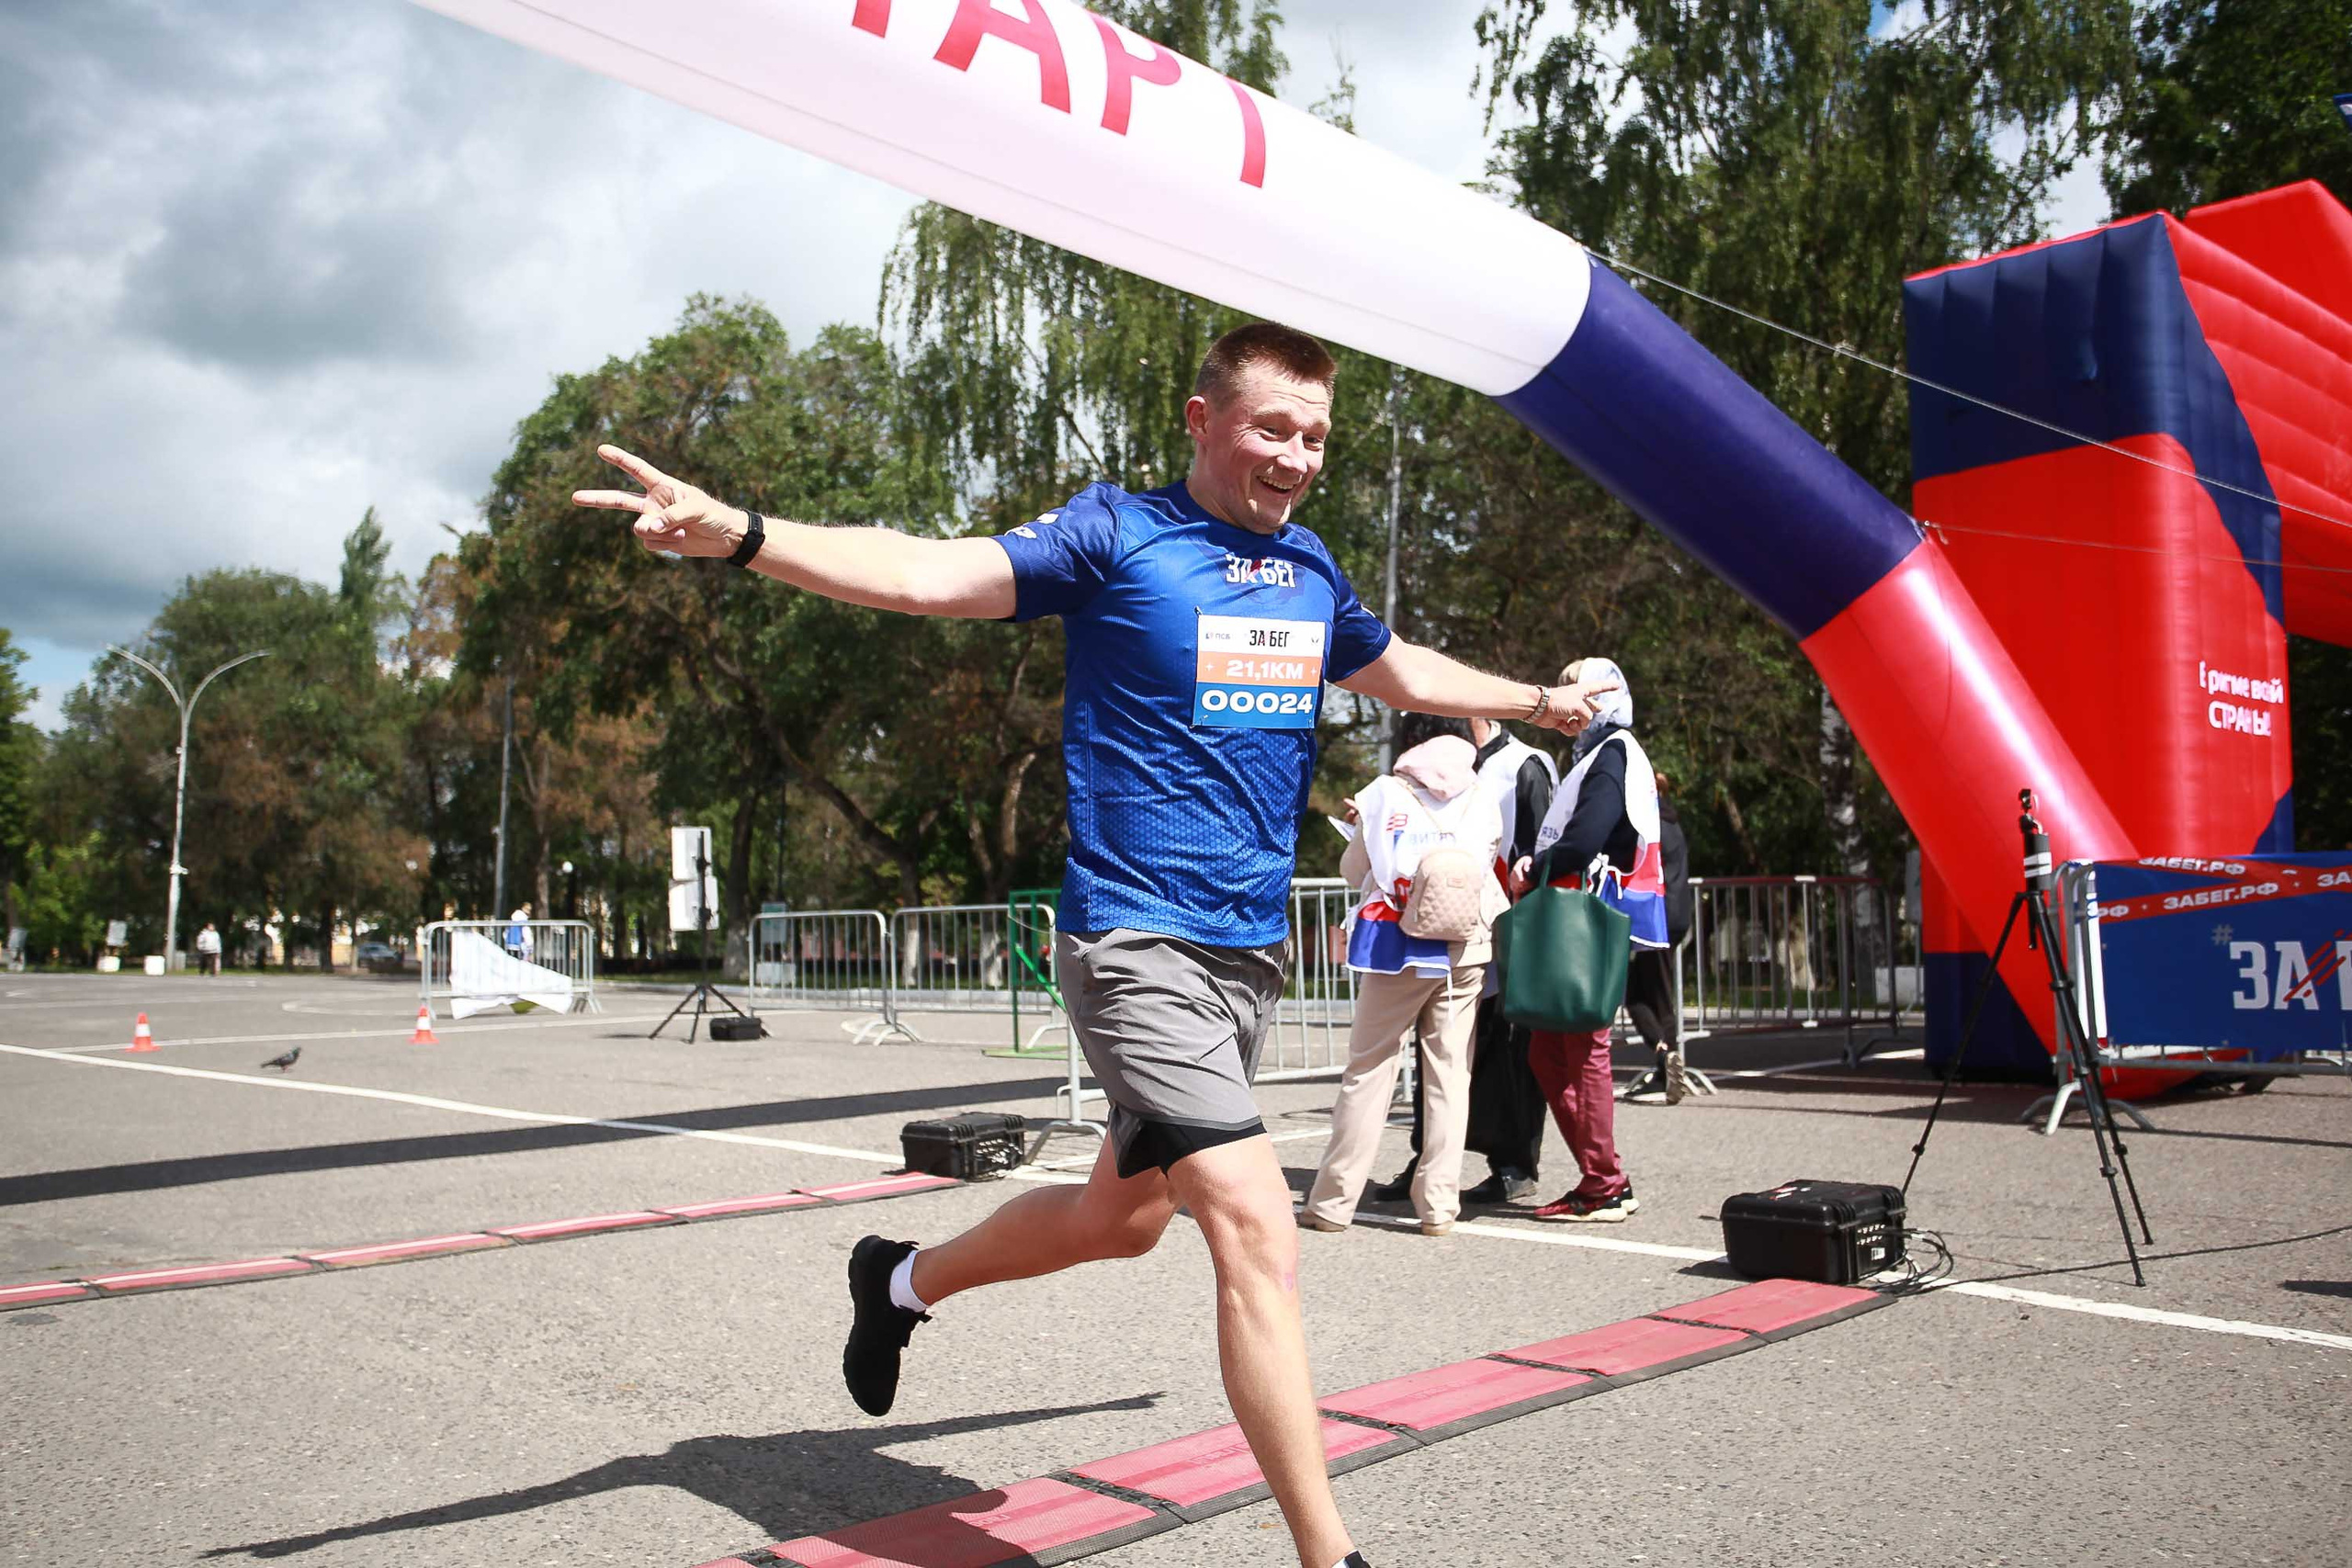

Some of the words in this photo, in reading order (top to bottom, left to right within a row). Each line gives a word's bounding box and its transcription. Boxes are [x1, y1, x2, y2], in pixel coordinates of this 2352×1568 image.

[1249, 629, 1266, 647] ЗА
[1269, 630, 1291, 649] БЕГ
[1201, 689, 1314, 715] 00024
[2163, 882, 2279, 910] ЗАБЕГ.РФ
